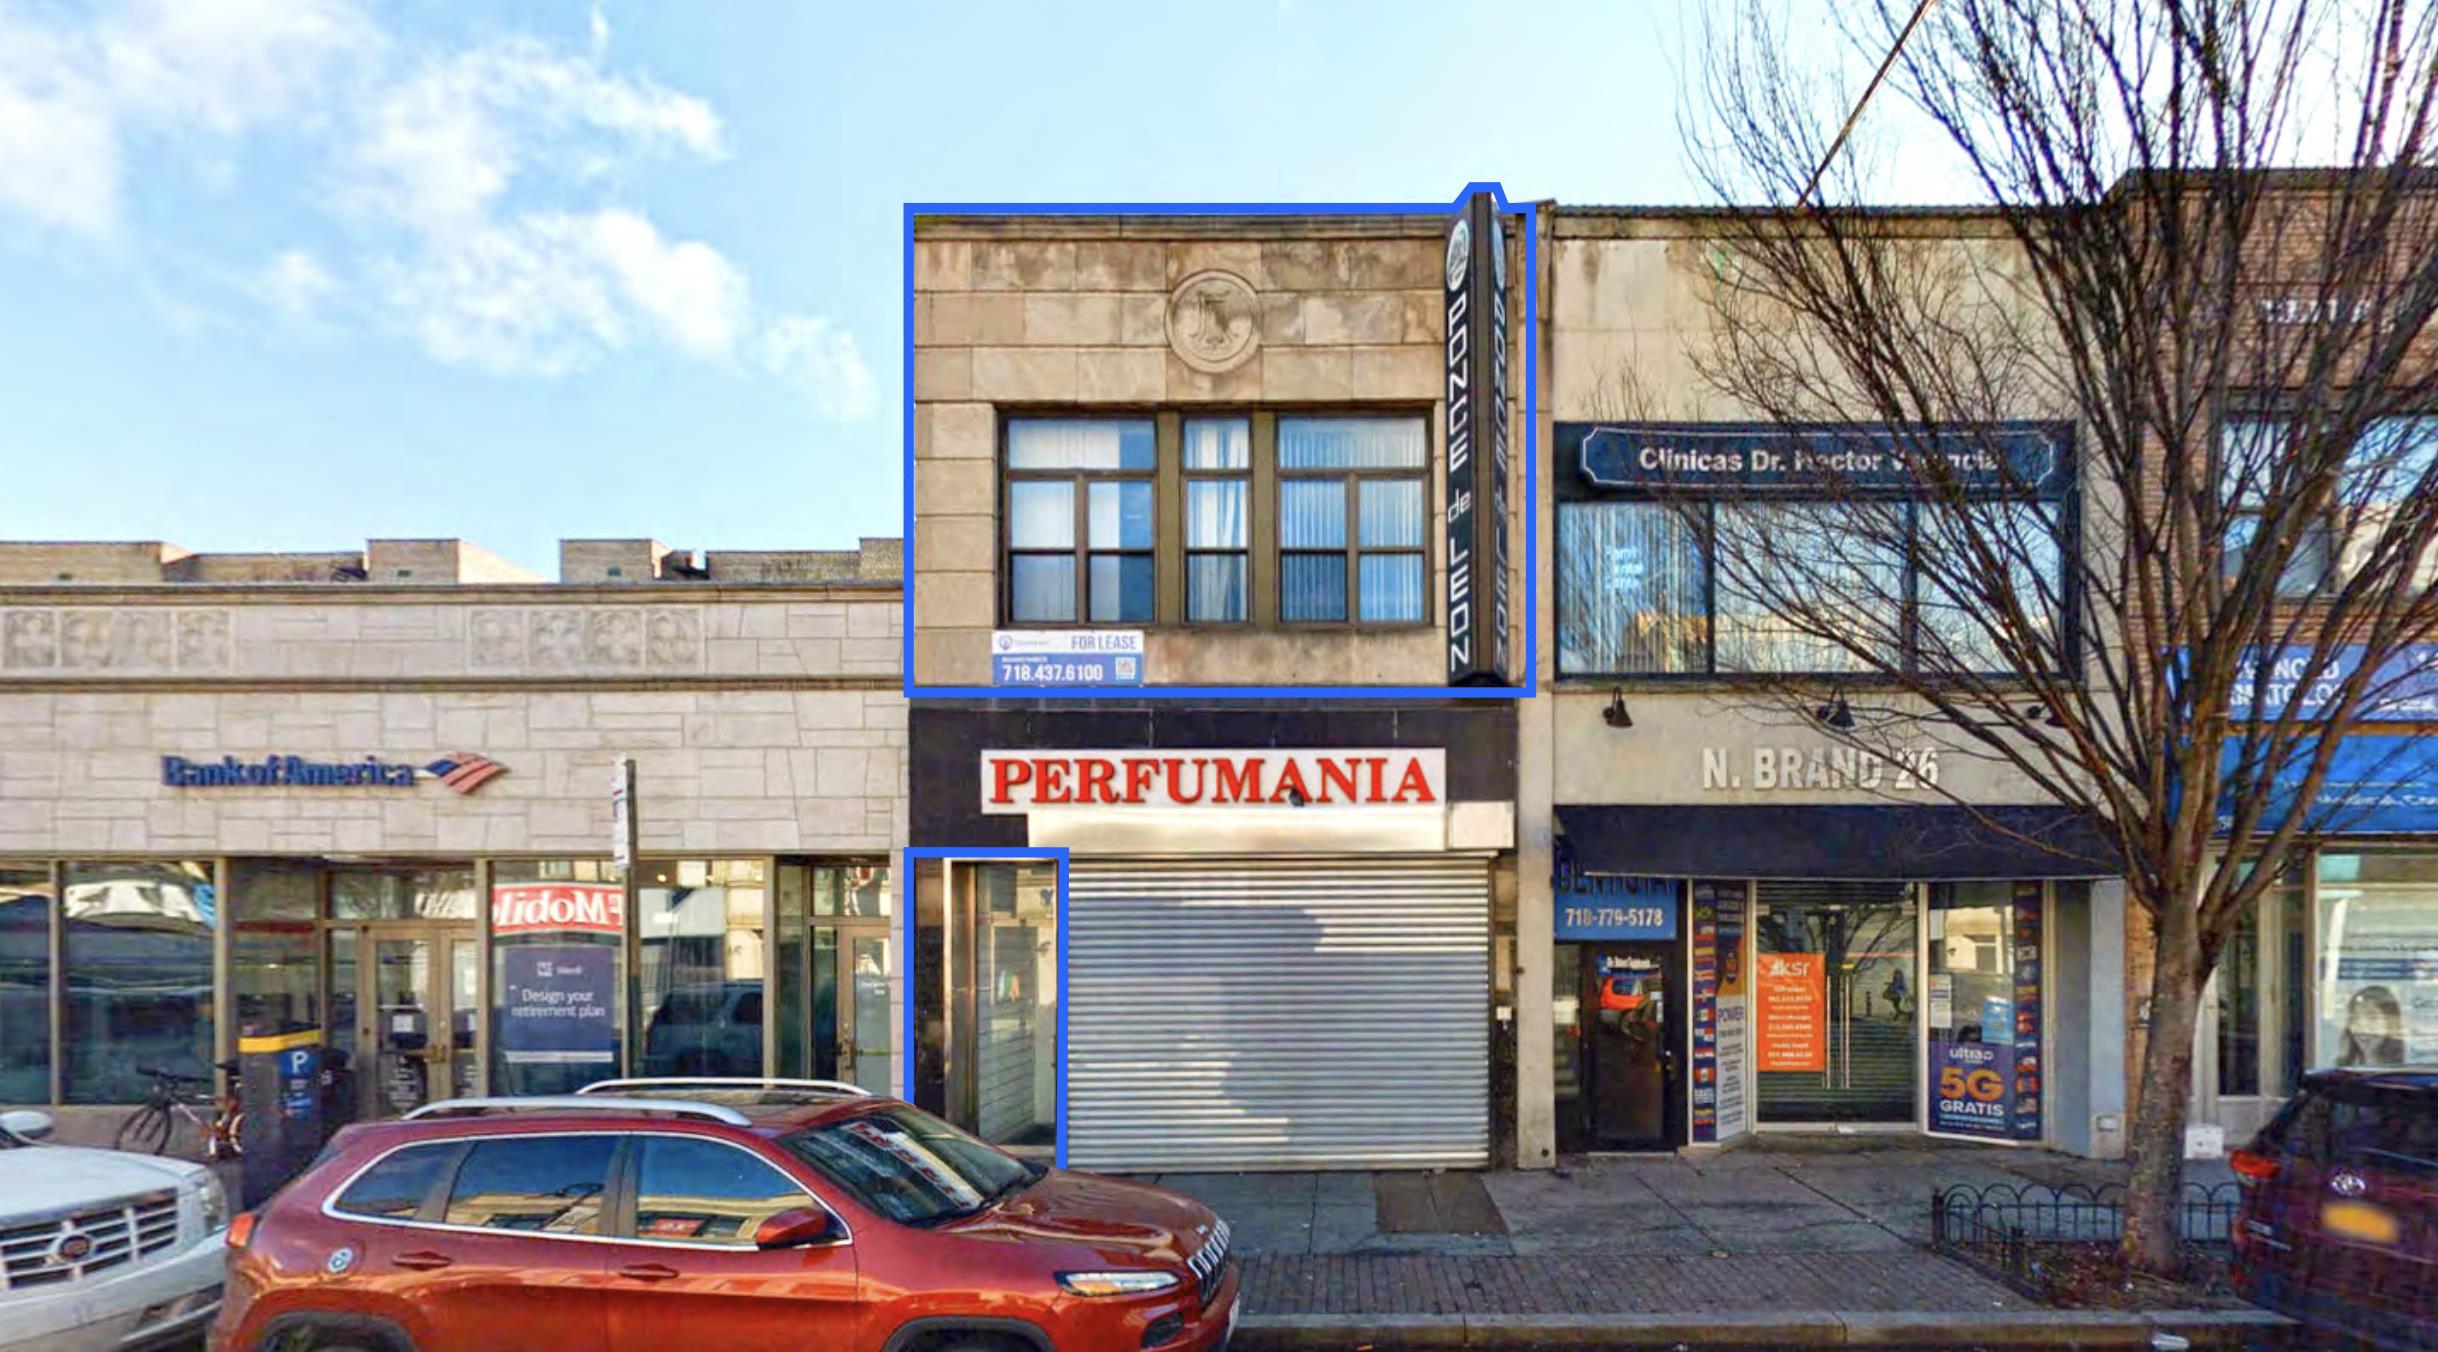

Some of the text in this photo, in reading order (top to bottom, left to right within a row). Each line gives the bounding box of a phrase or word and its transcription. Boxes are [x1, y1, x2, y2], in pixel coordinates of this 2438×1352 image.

[1750, 449, 1786, 471] Dr.
[1448, 291, 1471, 673] PONCE de LEON
[1071, 635, 1136, 650] FOR LEASE
[1002, 664, 1103, 681] 718.437.6100
[1702, 747, 1940, 790] N. BRAND 26
[988, 757, 1436, 805] PERFUMANIA
[522, 988, 594, 1004] Design your
[511, 1005, 605, 1018] retirement plan
[292, 1051, 308, 1075] P
[1940, 1066, 2006, 1103] 5G
[1939, 1099, 2005, 1117] GRATIS
